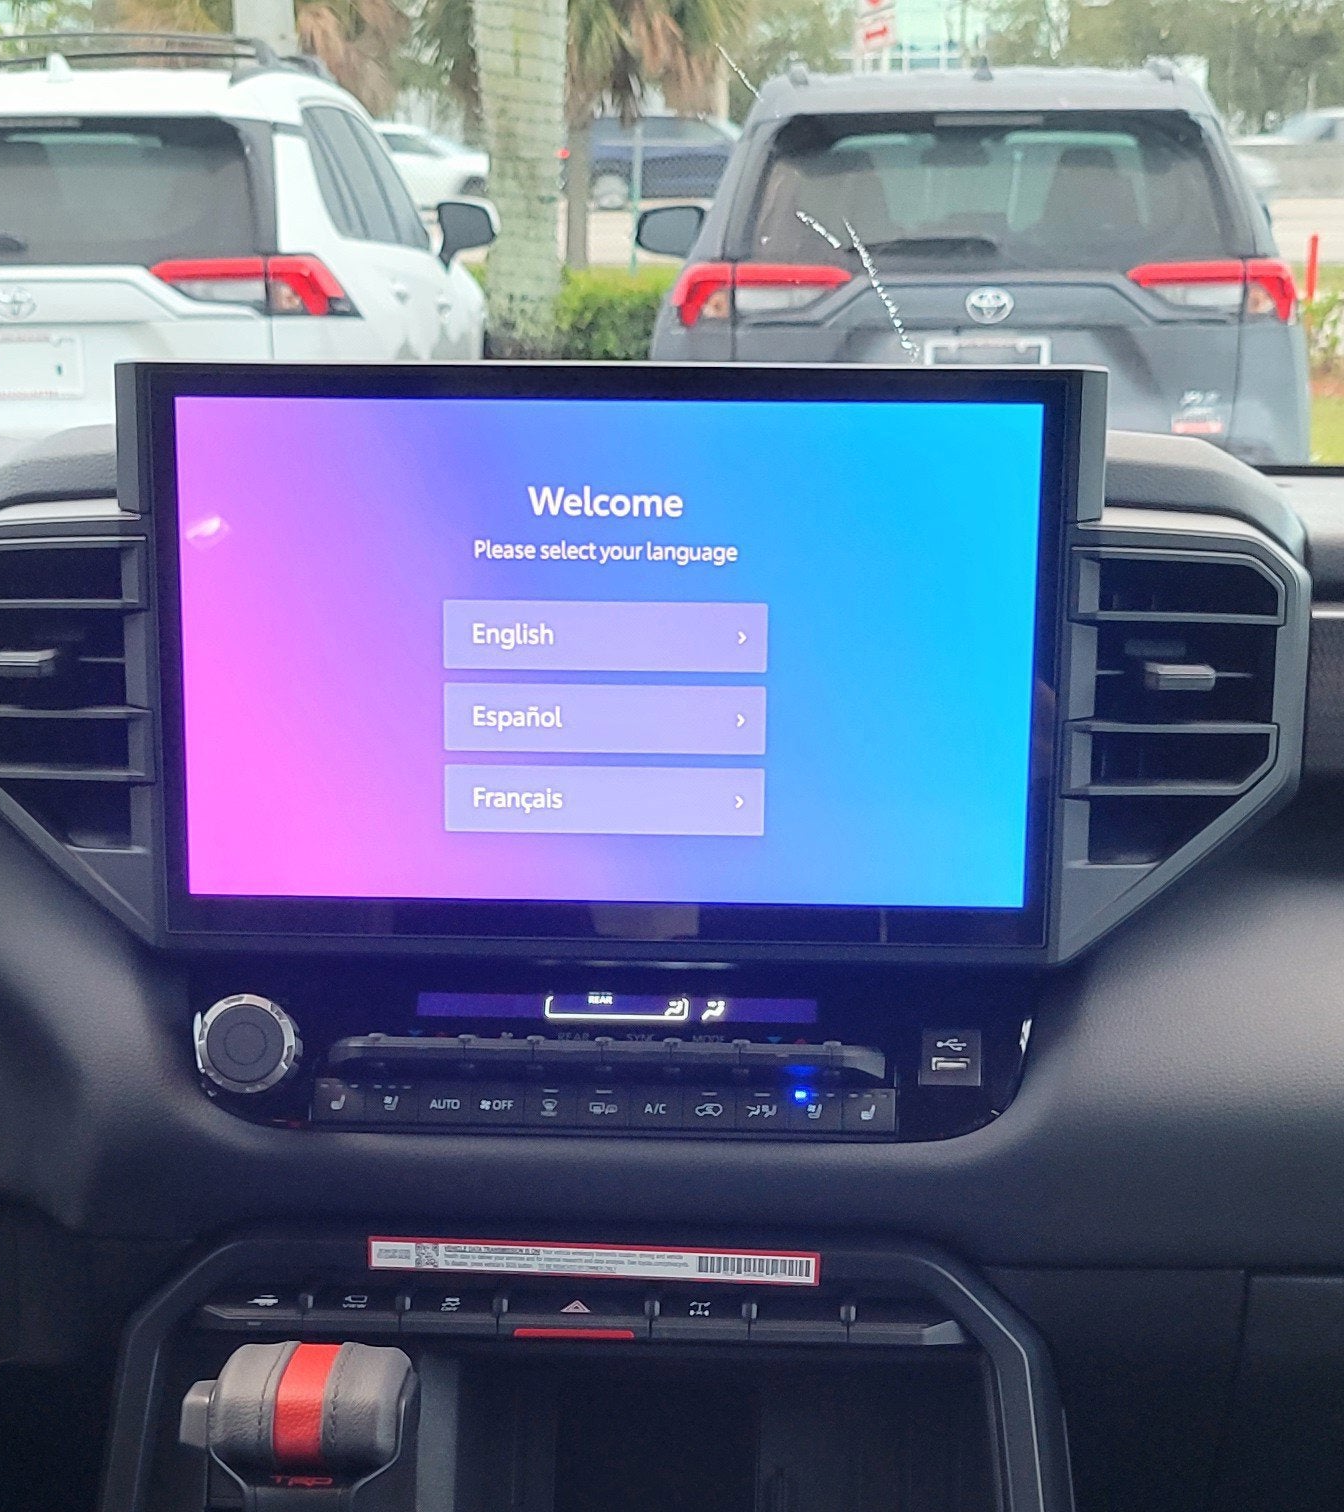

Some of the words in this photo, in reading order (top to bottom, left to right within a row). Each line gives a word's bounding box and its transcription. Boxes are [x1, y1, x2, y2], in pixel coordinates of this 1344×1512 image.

[528, 485, 684, 518] Welcome
[474, 540, 536, 560] Please
[540, 541, 596, 561] select
[599, 545, 641, 565] your
[647, 542, 738, 565] language
[472, 623, 554, 650] English
[472, 705, 563, 732] Español
[472, 788, 563, 813] Français
[429, 1098, 461, 1110] AUTO
[492, 1099, 514, 1111] OFF
[643, 1102, 667, 1116] A/C
[271, 1475, 333, 1488] TRD
